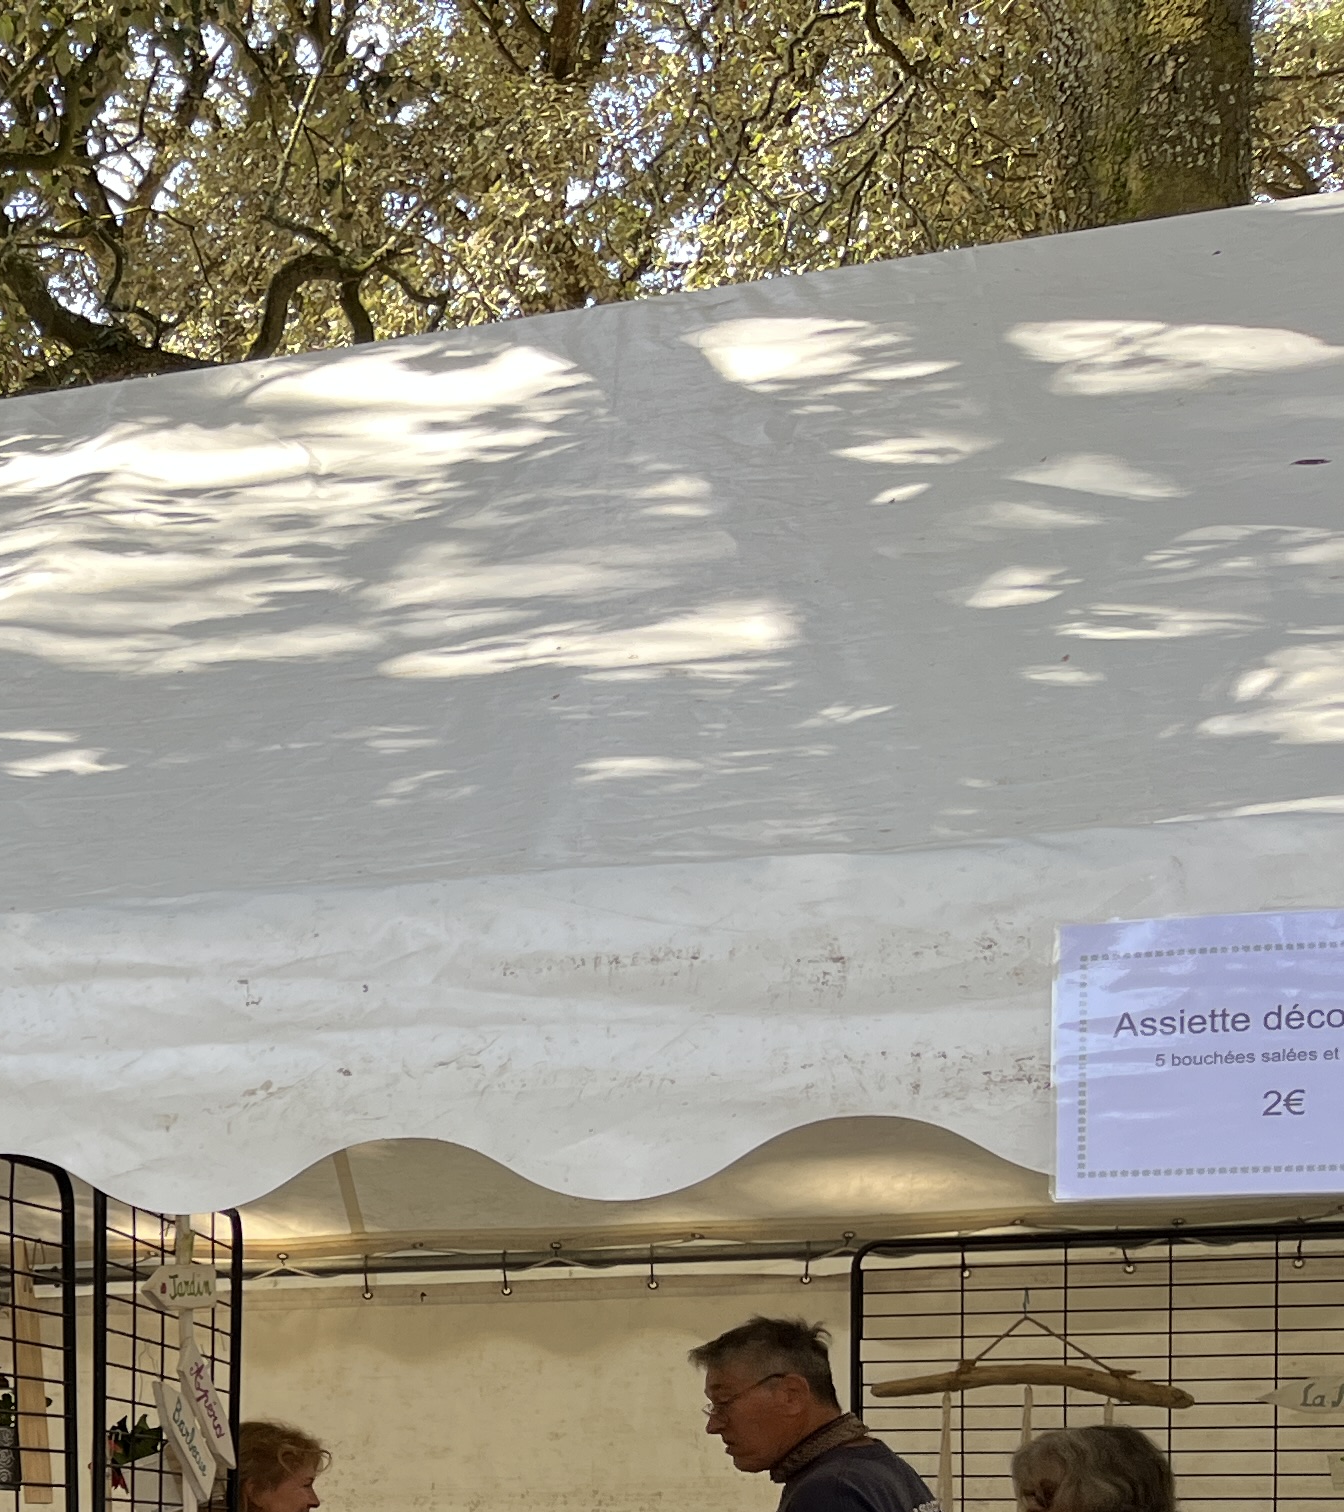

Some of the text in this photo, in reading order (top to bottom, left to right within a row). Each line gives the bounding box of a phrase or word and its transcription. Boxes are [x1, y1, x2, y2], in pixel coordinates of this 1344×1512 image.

[1112, 1008, 1251, 1039] Assiette
[1155, 1046, 1339, 1067] 5 bouchées salées et
[1261, 1088, 1306, 1117] 2€
